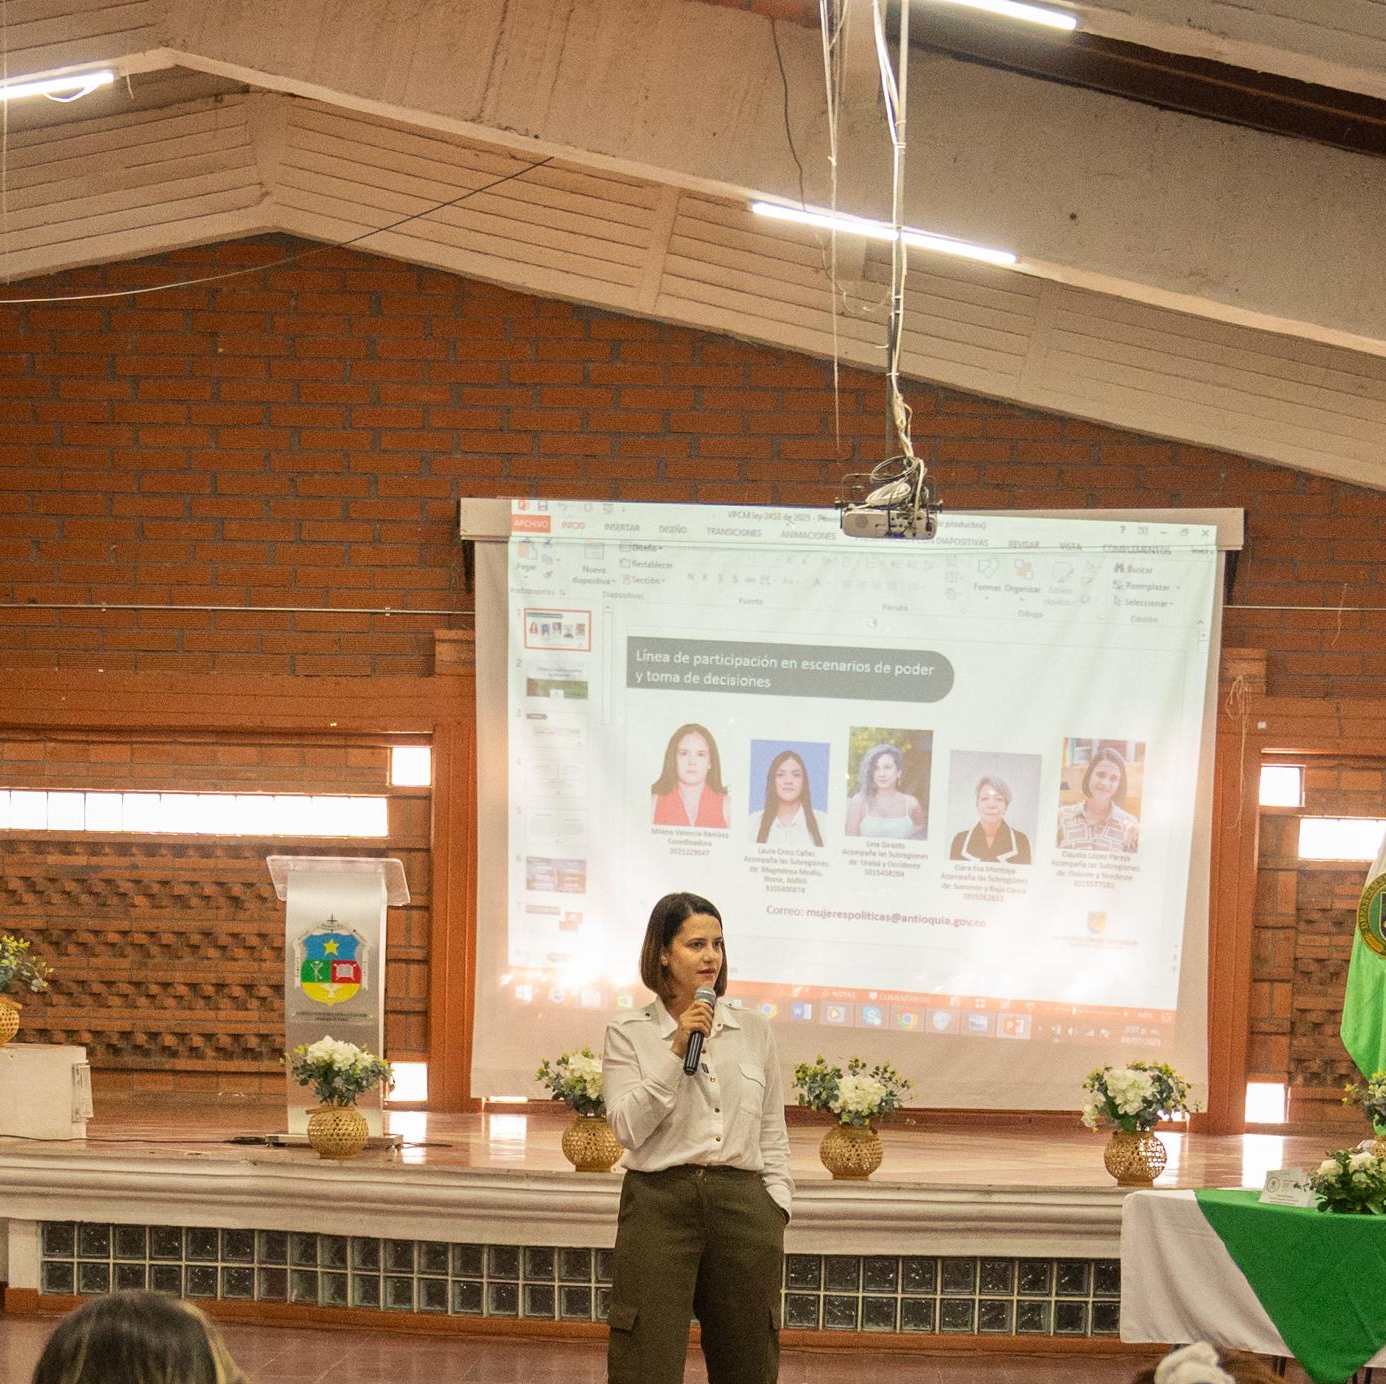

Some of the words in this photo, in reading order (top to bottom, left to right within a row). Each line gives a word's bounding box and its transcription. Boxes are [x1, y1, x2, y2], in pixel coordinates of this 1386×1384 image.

[514, 519, 549, 529] ARCHIVO
[604, 523, 641, 533] INSERTAR
[707, 528, 762, 538] TRANSICIONES
[780, 530, 837, 541] ANIMACIONES
[1059, 542, 1083, 551] VISTA
[635, 649, 670, 663] Línea
[673, 651, 690, 663] de
[693, 653, 778, 669] participación
[781, 659, 798, 669] en
[800, 660, 872, 673] escenarios
[874, 661, 892, 674] de
[894, 663, 933, 676] poder
[635, 672, 644, 684] y
[647, 671, 681, 683] toma
[683, 672, 701, 684] de
[704, 673, 772, 688] decisiones
[766, 904, 804, 916] Correo:
